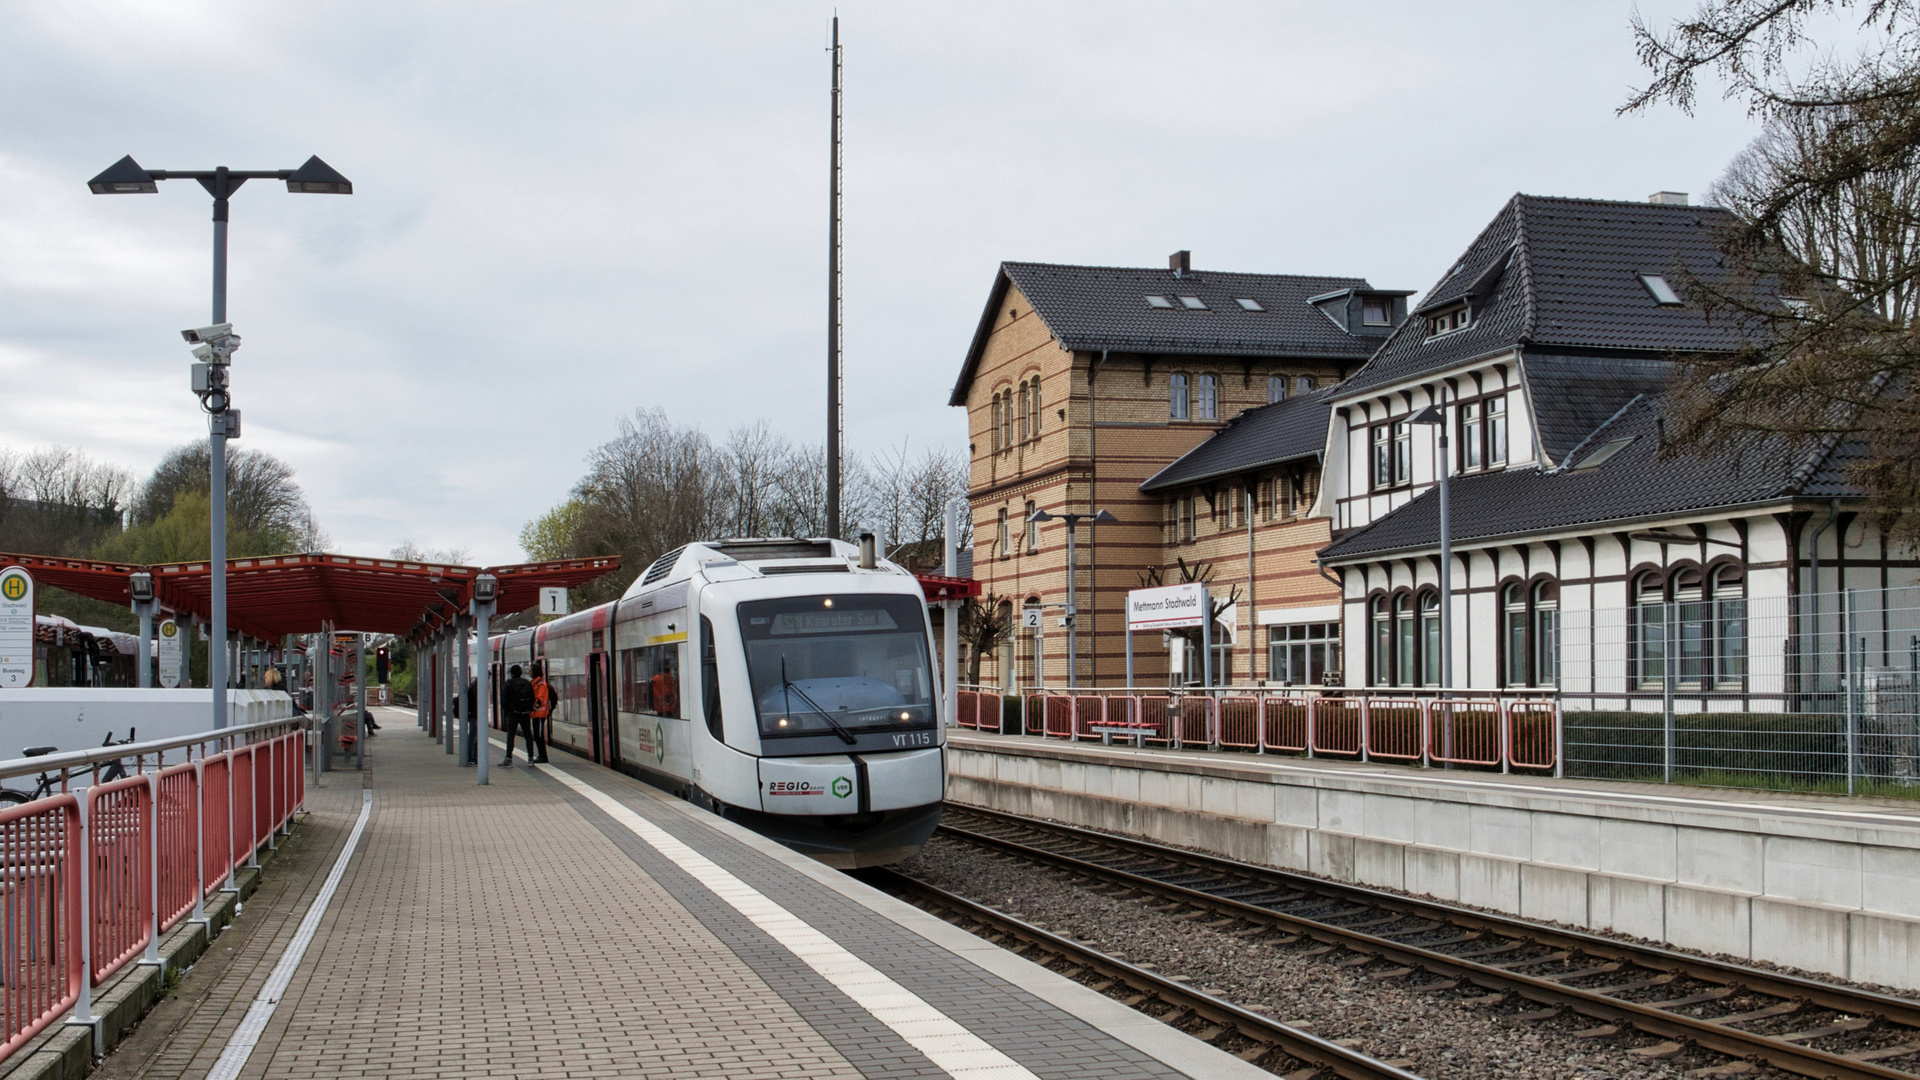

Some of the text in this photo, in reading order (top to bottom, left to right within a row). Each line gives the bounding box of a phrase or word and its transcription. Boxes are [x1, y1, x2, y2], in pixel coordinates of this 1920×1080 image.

[9, 580, 20, 595] H
[551, 595, 556, 611] 1
[1133, 595, 1197, 612] Mettmann Stadtwald
[806, 614, 853, 627] Kaarster
[858, 612, 876, 625] See
[1029, 614, 1037, 625] 2
[892, 733, 930, 747] VT 115
[769, 781, 810, 790] REGIO
